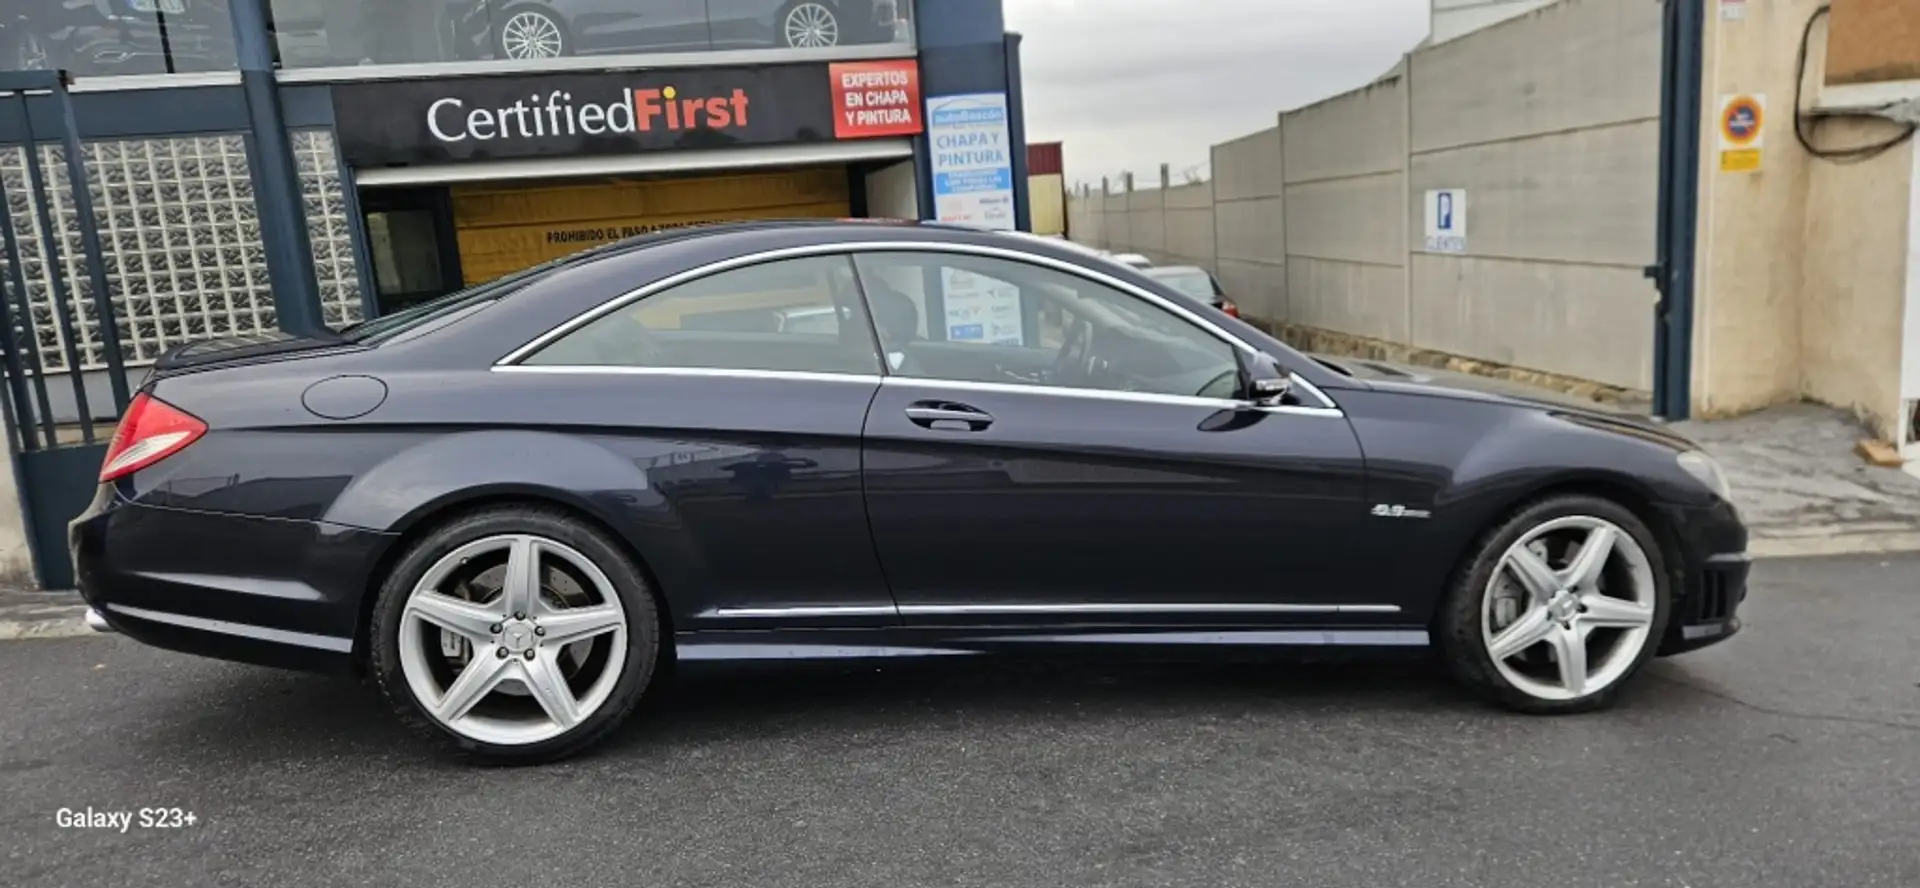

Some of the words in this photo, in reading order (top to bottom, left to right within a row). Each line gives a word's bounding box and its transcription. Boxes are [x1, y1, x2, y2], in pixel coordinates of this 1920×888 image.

[842, 70, 908, 88] EXPERTOS
[845, 92, 863, 107] EN
[865, 90, 908, 106] CHAPA
[427, 86, 748, 142] CertifiedFirst
[845, 111, 854, 126] Y
[857, 108, 912, 125] PINTURA
[937, 132, 987, 149] CHAPA
[991, 131, 999, 144] Y
[938, 149, 1004, 167] PINTURA
[547, 227, 604, 244] PROHIBIDO
[607, 227, 619, 240] EL
[622, 225, 648, 239] PASO
